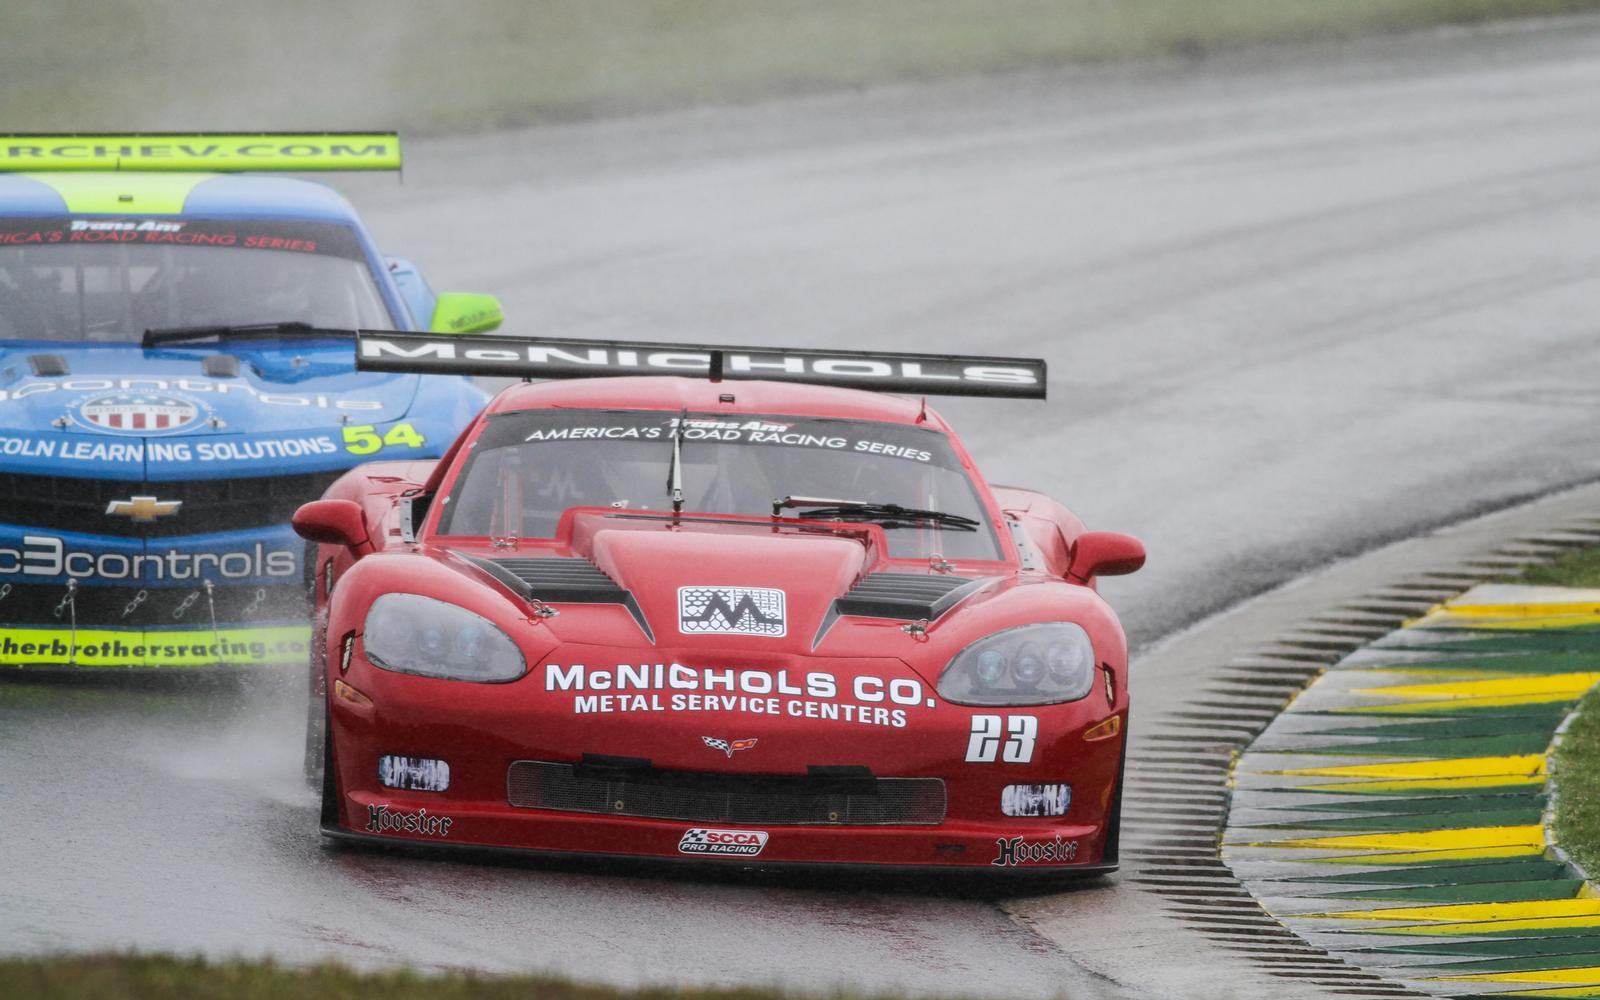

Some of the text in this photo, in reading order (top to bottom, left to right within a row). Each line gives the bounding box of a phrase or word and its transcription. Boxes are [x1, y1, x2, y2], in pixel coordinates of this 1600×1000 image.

[70, 231, 139, 242] ROAD
[144, 231, 237, 246] RACING
[244, 235, 317, 251] SERIES
[361, 339, 1037, 384] McNICHOLS
[0, 379, 384, 410] controls
[60, 442, 192, 461] LEARNING
[196, 436, 337, 461] SOLUTIONS
[342, 423, 425, 455] 54
[525, 427, 662, 441] AMERICA'S
[748, 431, 848, 449] RACING
[855, 440, 932, 462] SERIES
[0, 535, 296, 579] c3controls
[0, 637, 311, 661] herbrothersracing.co
[545, 663, 936, 708] McNICHOLS CO.
[575, 694, 907, 728] METAL SERVICE CENTERS
[964, 714, 1038, 763] 23
[366, 803, 453, 836] Hoosier
[681, 843, 758, 853] PRO RACING
[706, 833, 761, 844] SCCA
[992, 834, 1079, 866] Hoosier
